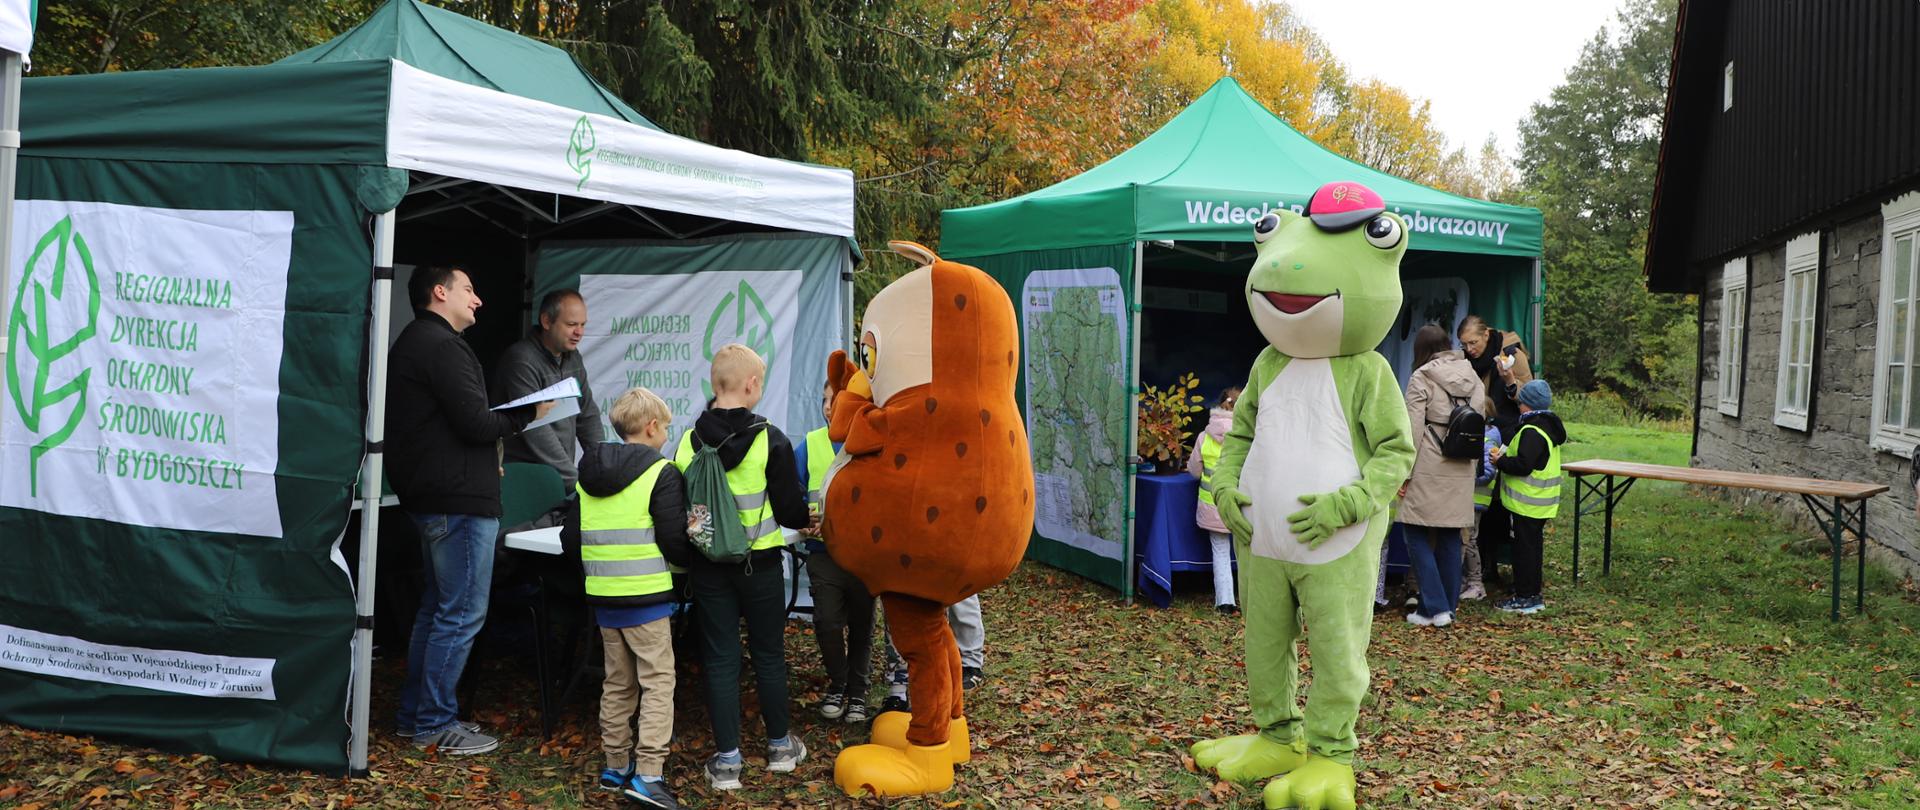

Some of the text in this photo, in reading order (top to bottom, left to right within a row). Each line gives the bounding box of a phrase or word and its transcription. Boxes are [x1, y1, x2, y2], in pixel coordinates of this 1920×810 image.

[1185, 200, 1284, 225] Wdeck
[1395, 206, 1510, 245] obrazowy
[115, 271, 232, 308] REGIONALNA
[110, 315, 198, 352] DYREKCJA
[107, 358, 194, 396] OCHRONY
[98, 396, 226, 445] ŚRODOWISKA
[116, 448, 245, 490] BYDGOSZCZY
[2, 650, 45, 667] Ochrony
[47, 654, 100, 673] Środowiska
[108, 667, 165, 681] Gospodarki
[169, 673, 207, 689] Wodnej
[220, 681, 263, 692] Toruniu
[6, 634, 75, 653] Dofinansowano
[86, 650, 128, 662] środków
[132, 654, 213, 674] Wojewódzkiego
[215, 663, 262, 677] Fundusza
